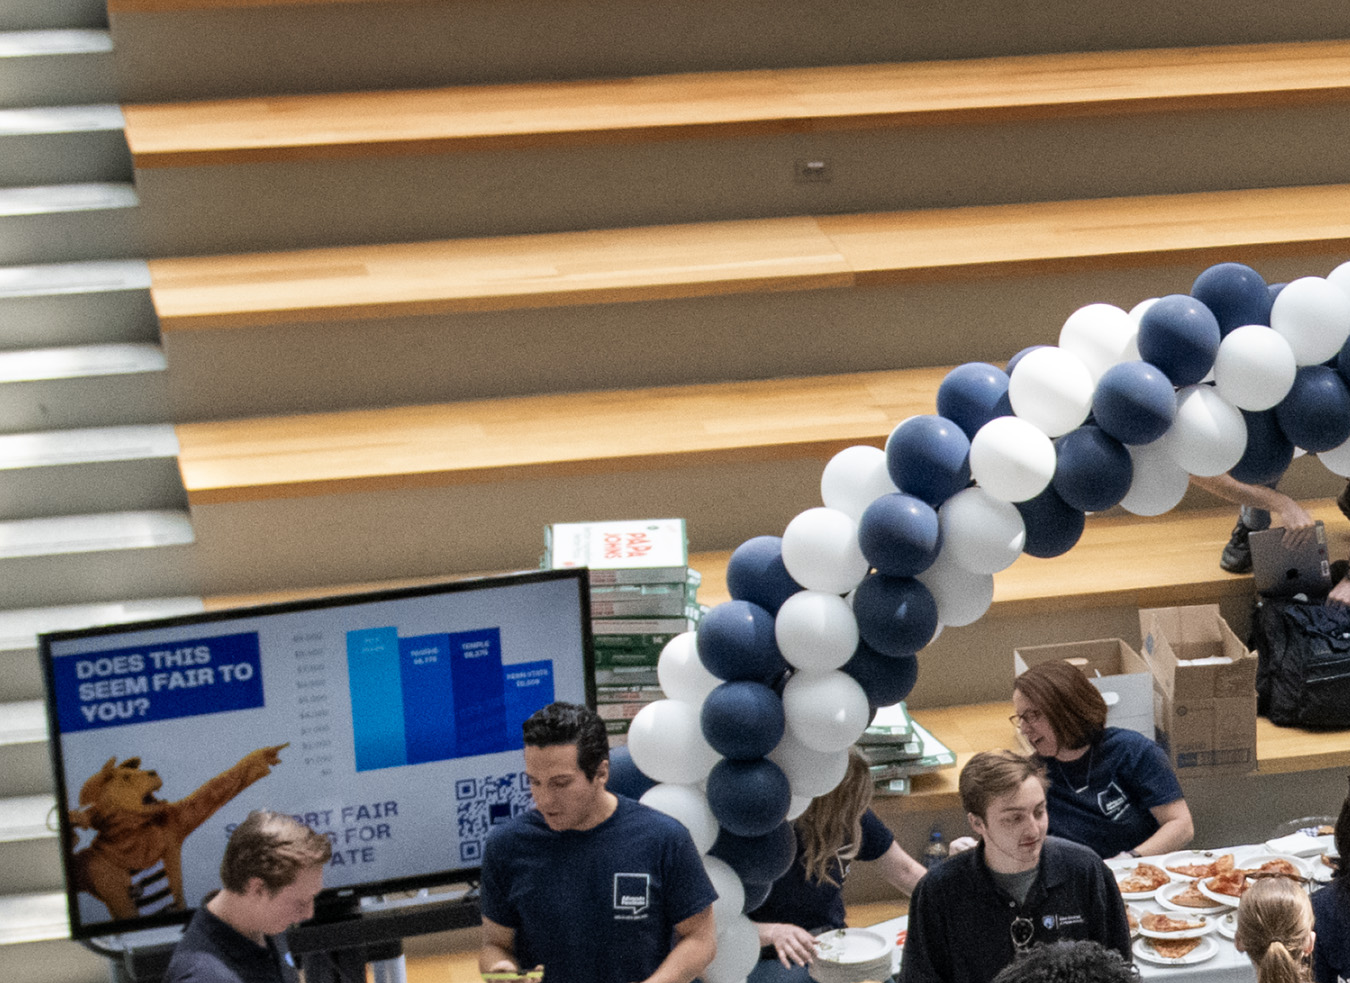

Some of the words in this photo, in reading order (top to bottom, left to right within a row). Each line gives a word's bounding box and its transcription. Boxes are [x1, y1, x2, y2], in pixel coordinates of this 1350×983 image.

[625, 531, 653, 559] PAPA
[75, 653, 145, 680] DOES
[149, 645, 211, 670] THIS
[78, 675, 149, 701] SEEM
[151, 667, 215, 692] FAIR
[218, 662, 253, 683] TO
[80, 698, 150, 723] YOU?
[341, 801, 399, 823] FAIR
[345, 823, 392, 844] FOR
